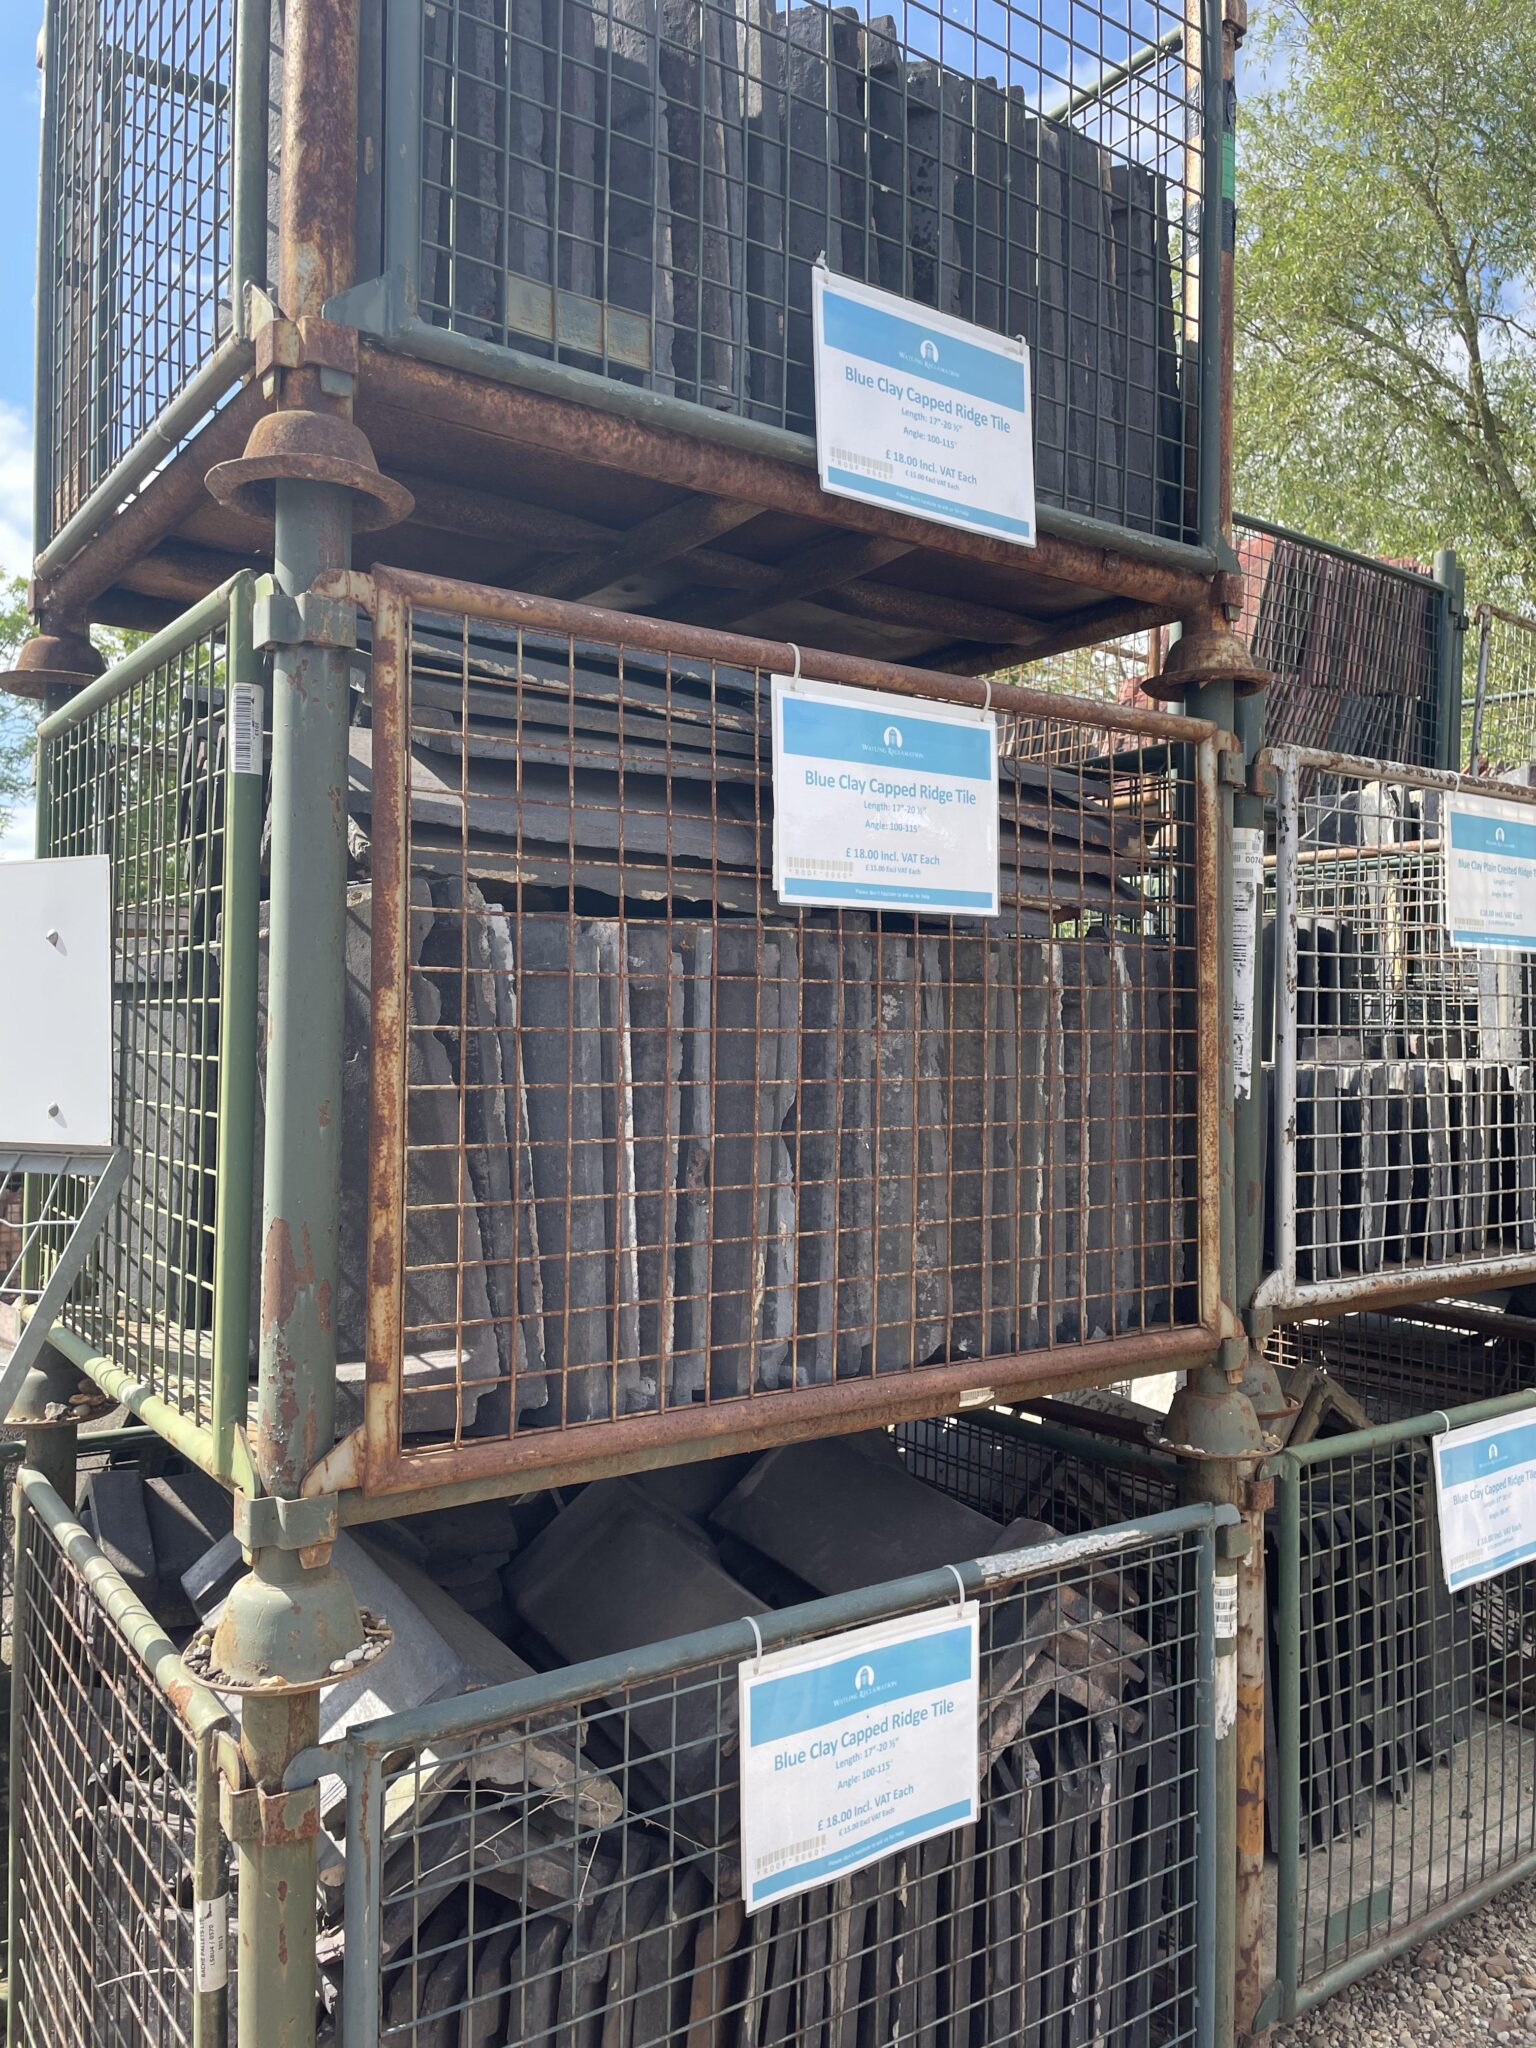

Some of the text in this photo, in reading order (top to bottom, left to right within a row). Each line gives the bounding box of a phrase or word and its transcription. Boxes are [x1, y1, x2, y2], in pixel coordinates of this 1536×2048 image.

[845, 366, 1011, 433] Blue Clay Capped Ridge Tile
[901, 407, 928, 421] Length:
[903, 426, 926, 439] Angle:
[886, 449, 977, 485] £ 18.00 Incl. VAT Each
[936, 479, 946, 487] VAT
[947, 482, 960, 490] Each
[805, 770, 976, 805] Blue Clay Capped Ridge Tile
[864, 800, 890, 812] Length:
[865, 819, 889, 831] Angle:
[846, 847, 940, 865] £ 18.00 Incl. VAT Each
[1458, 858, 1470, 869] Blue
[1471, 860, 1482, 872] Clay
[1452, 1493, 1469, 1505] Blue
[1470, 1488, 1484, 1500] Clay
[1485, 1478, 1507, 1495] Capped
[1507, 1473, 1524, 1486] Ridge
[774, 1699, 954, 1772] Blue Clay Capped Ridge Tile
[835, 1753, 862, 1769] Length:
[837, 1775, 861, 1790] Angle:
[817, 1783, 914, 1831] £ 18.00 Incl. VAT Each
[871, 1811, 882, 1821] VAT
[882, 1807, 895, 1817] Each
